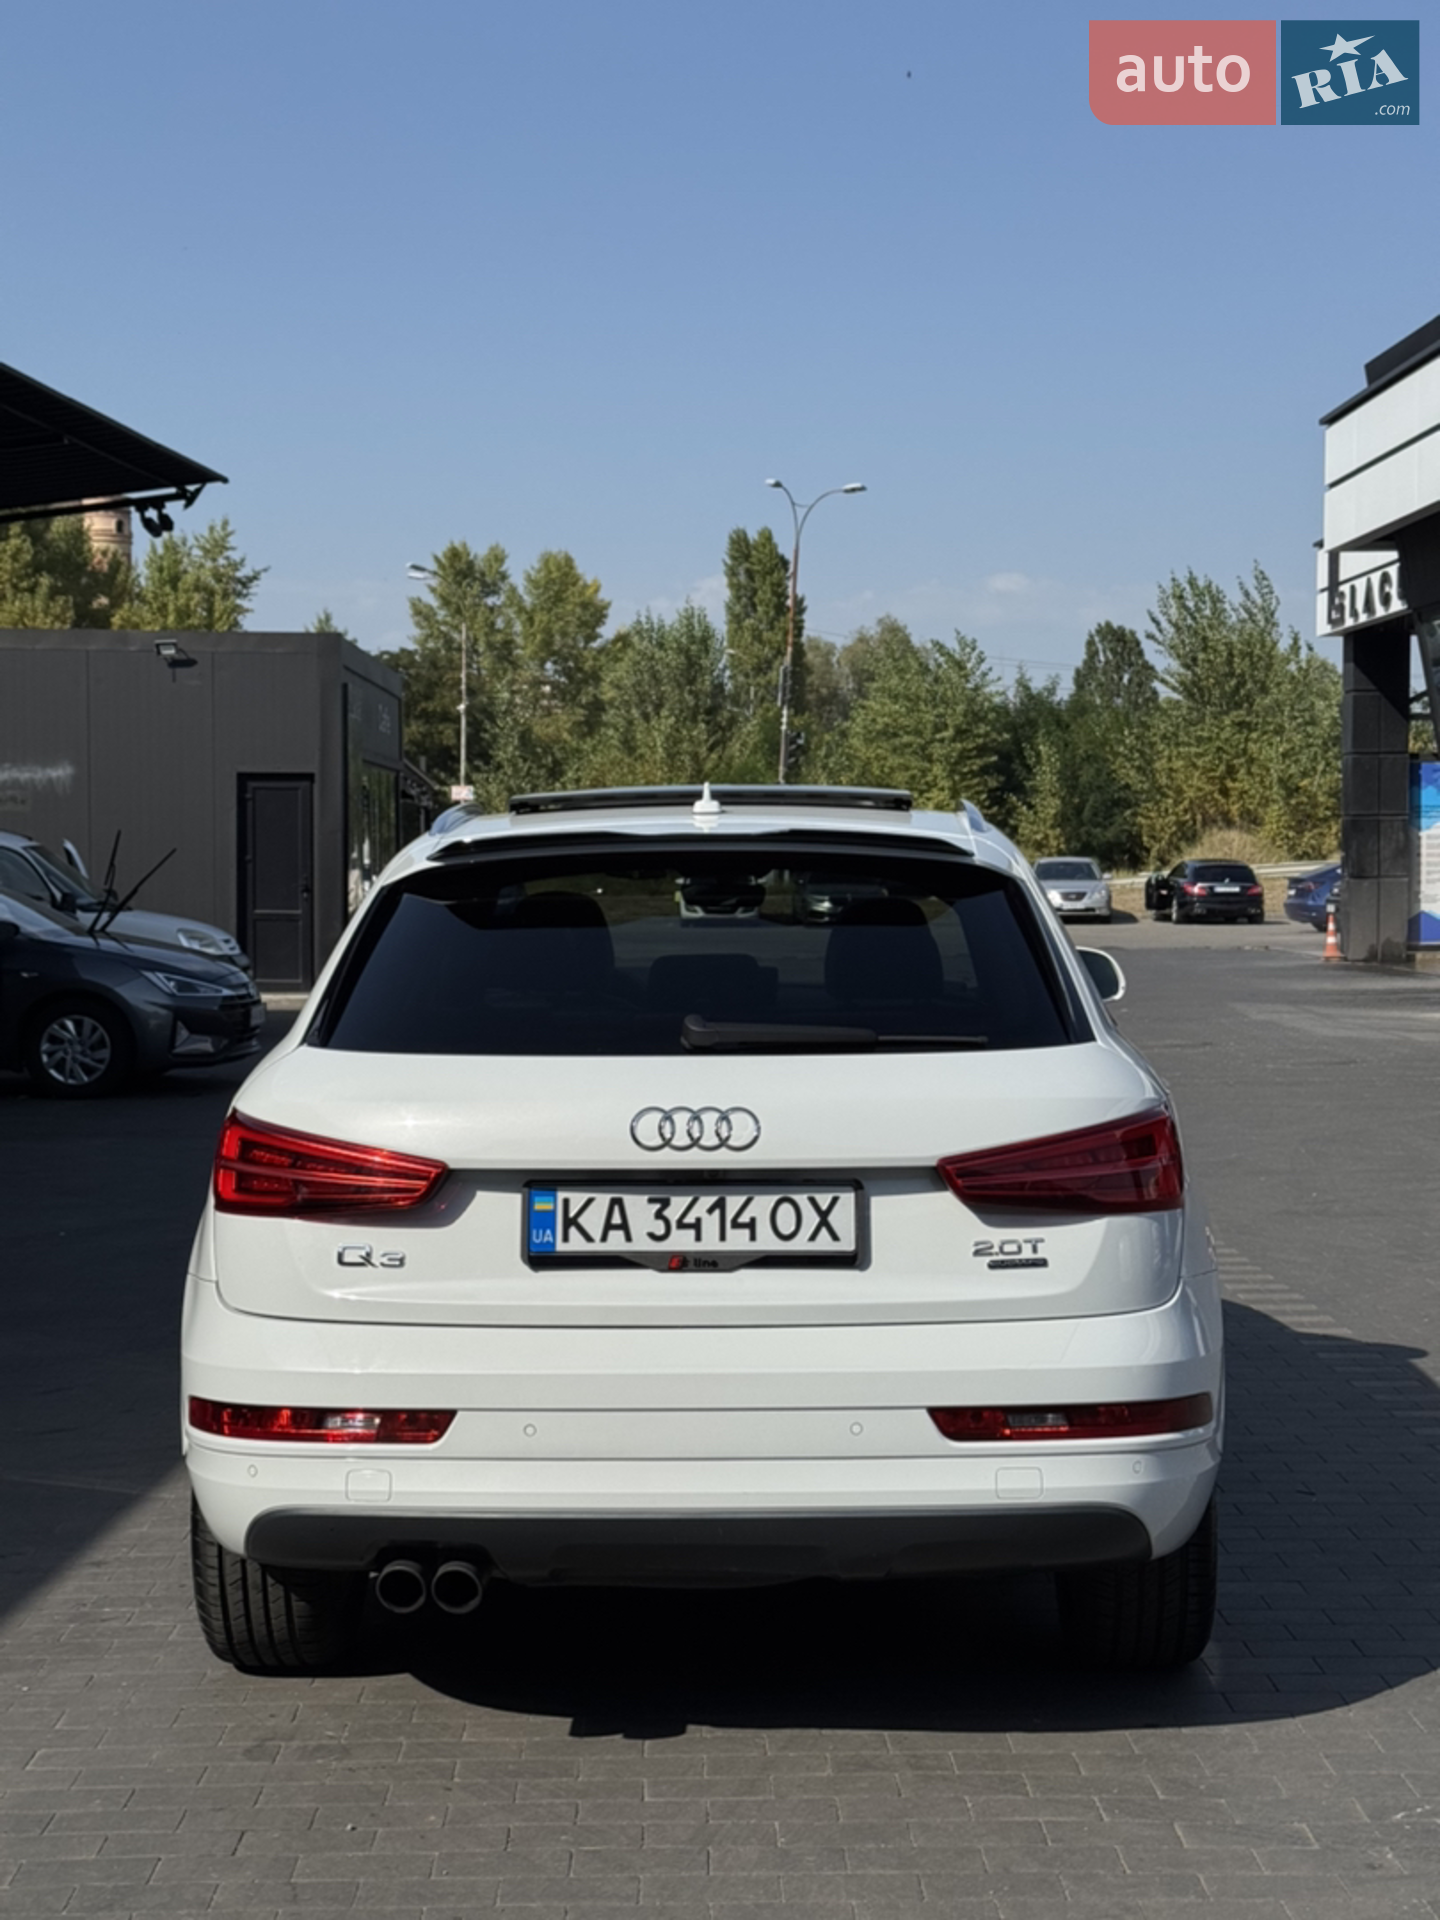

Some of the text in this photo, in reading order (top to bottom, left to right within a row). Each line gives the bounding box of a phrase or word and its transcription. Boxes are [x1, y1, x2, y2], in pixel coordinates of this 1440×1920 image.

[1327, 564, 1404, 629] BLAC
[562, 1195, 841, 1243] KA 3414 OX
[532, 1229, 554, 1243] UA
[972, 1238, 1046, 1257] 2.0T
[337, 1243, 406, 1268] Q3
